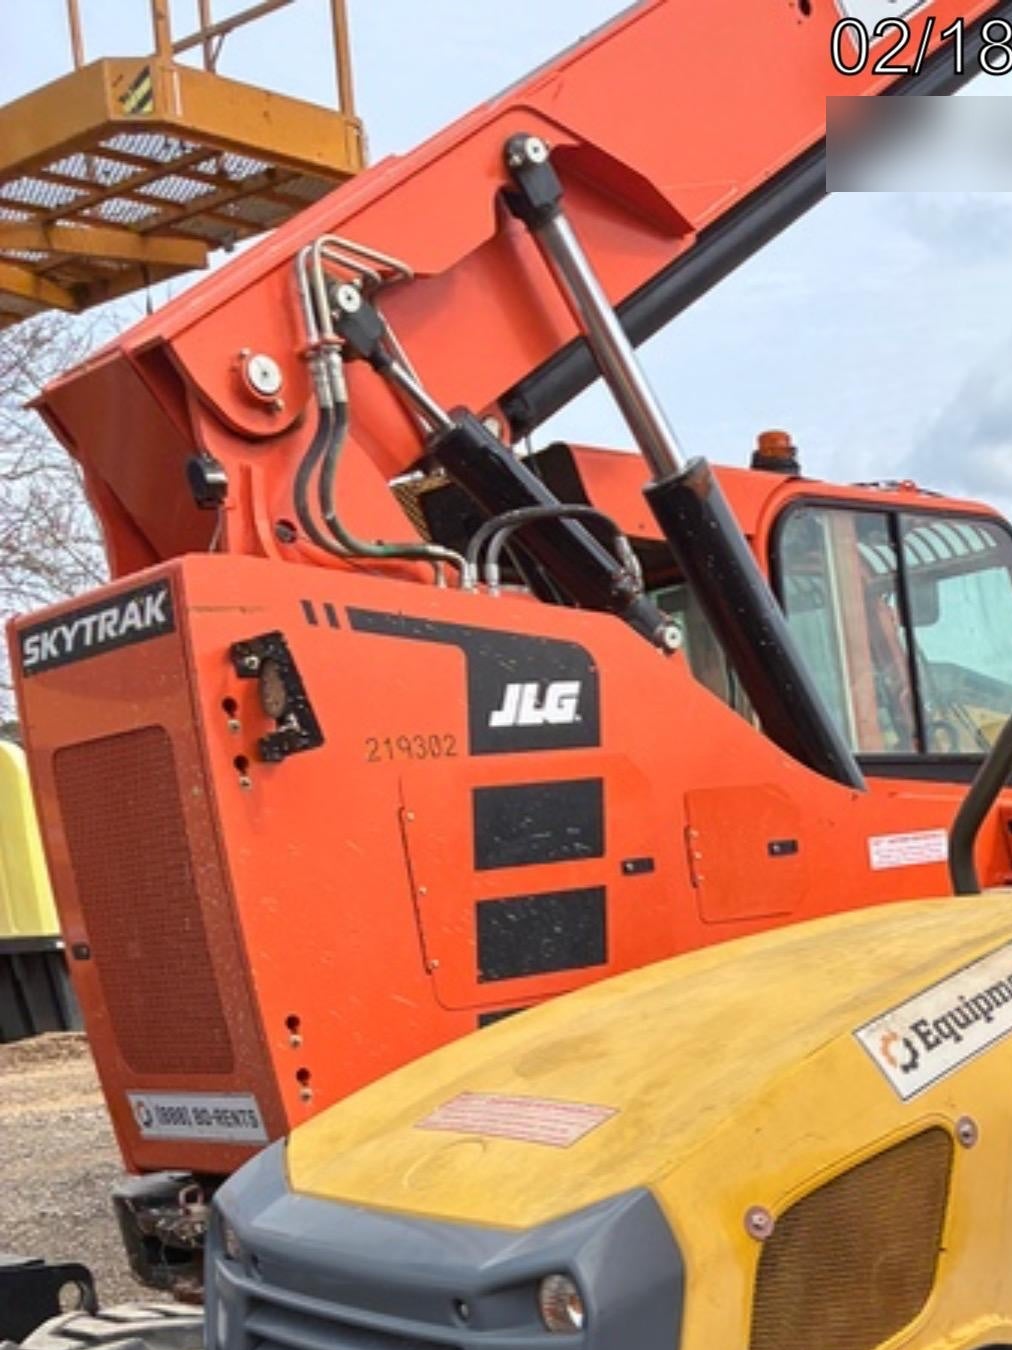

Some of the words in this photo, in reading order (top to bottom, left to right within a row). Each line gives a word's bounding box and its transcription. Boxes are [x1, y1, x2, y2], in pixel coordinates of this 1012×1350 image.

[22, 591, 167, 665] SKYTRAK
[489, 680, 580, 728] JLG
[365, 735, 458, 763] 219302
